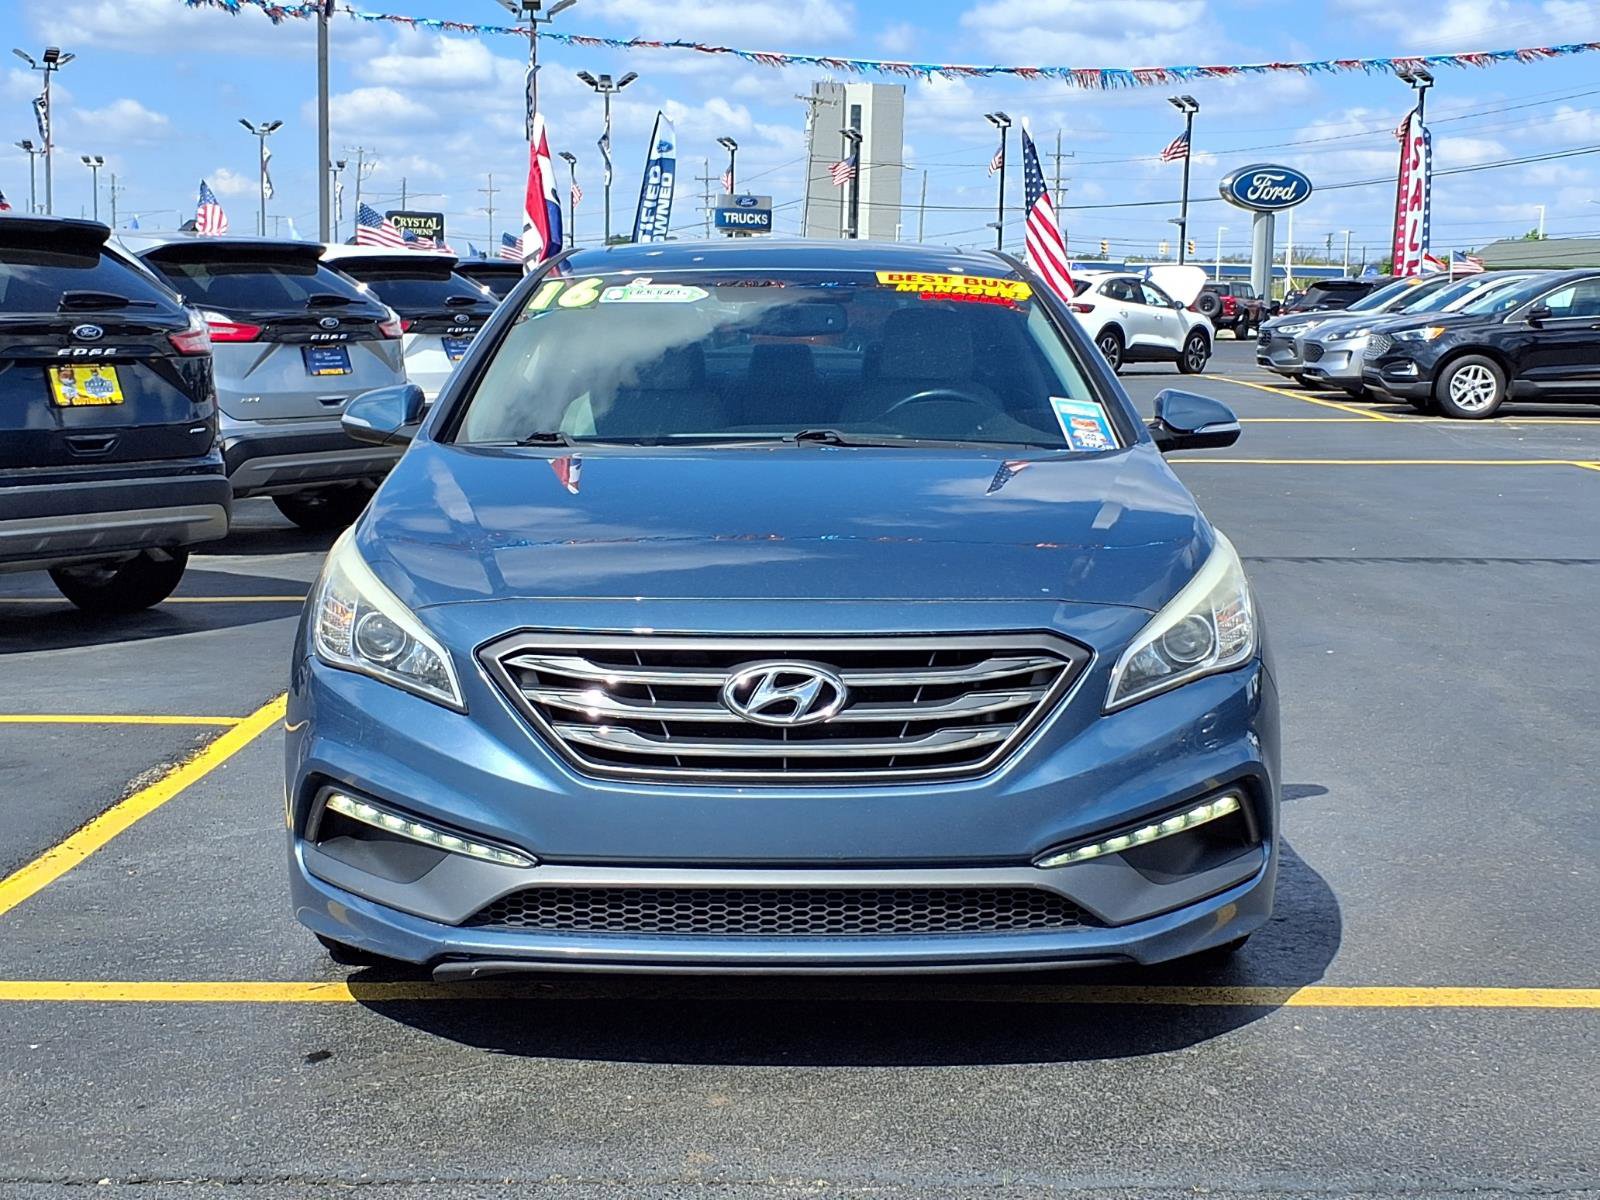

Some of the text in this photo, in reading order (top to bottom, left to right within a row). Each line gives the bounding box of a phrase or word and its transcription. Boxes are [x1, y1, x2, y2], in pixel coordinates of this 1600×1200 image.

[1247, 173, 1298, 201] Ford
[391, 215, 442, 230] CRYSTAL
[723, 212, 768, 225] TRUCKS
[888, 274, 1014, 289] BEST BUY
[528, 278, 603, 310] 16
[57, 348, 117, 356] EDGE
